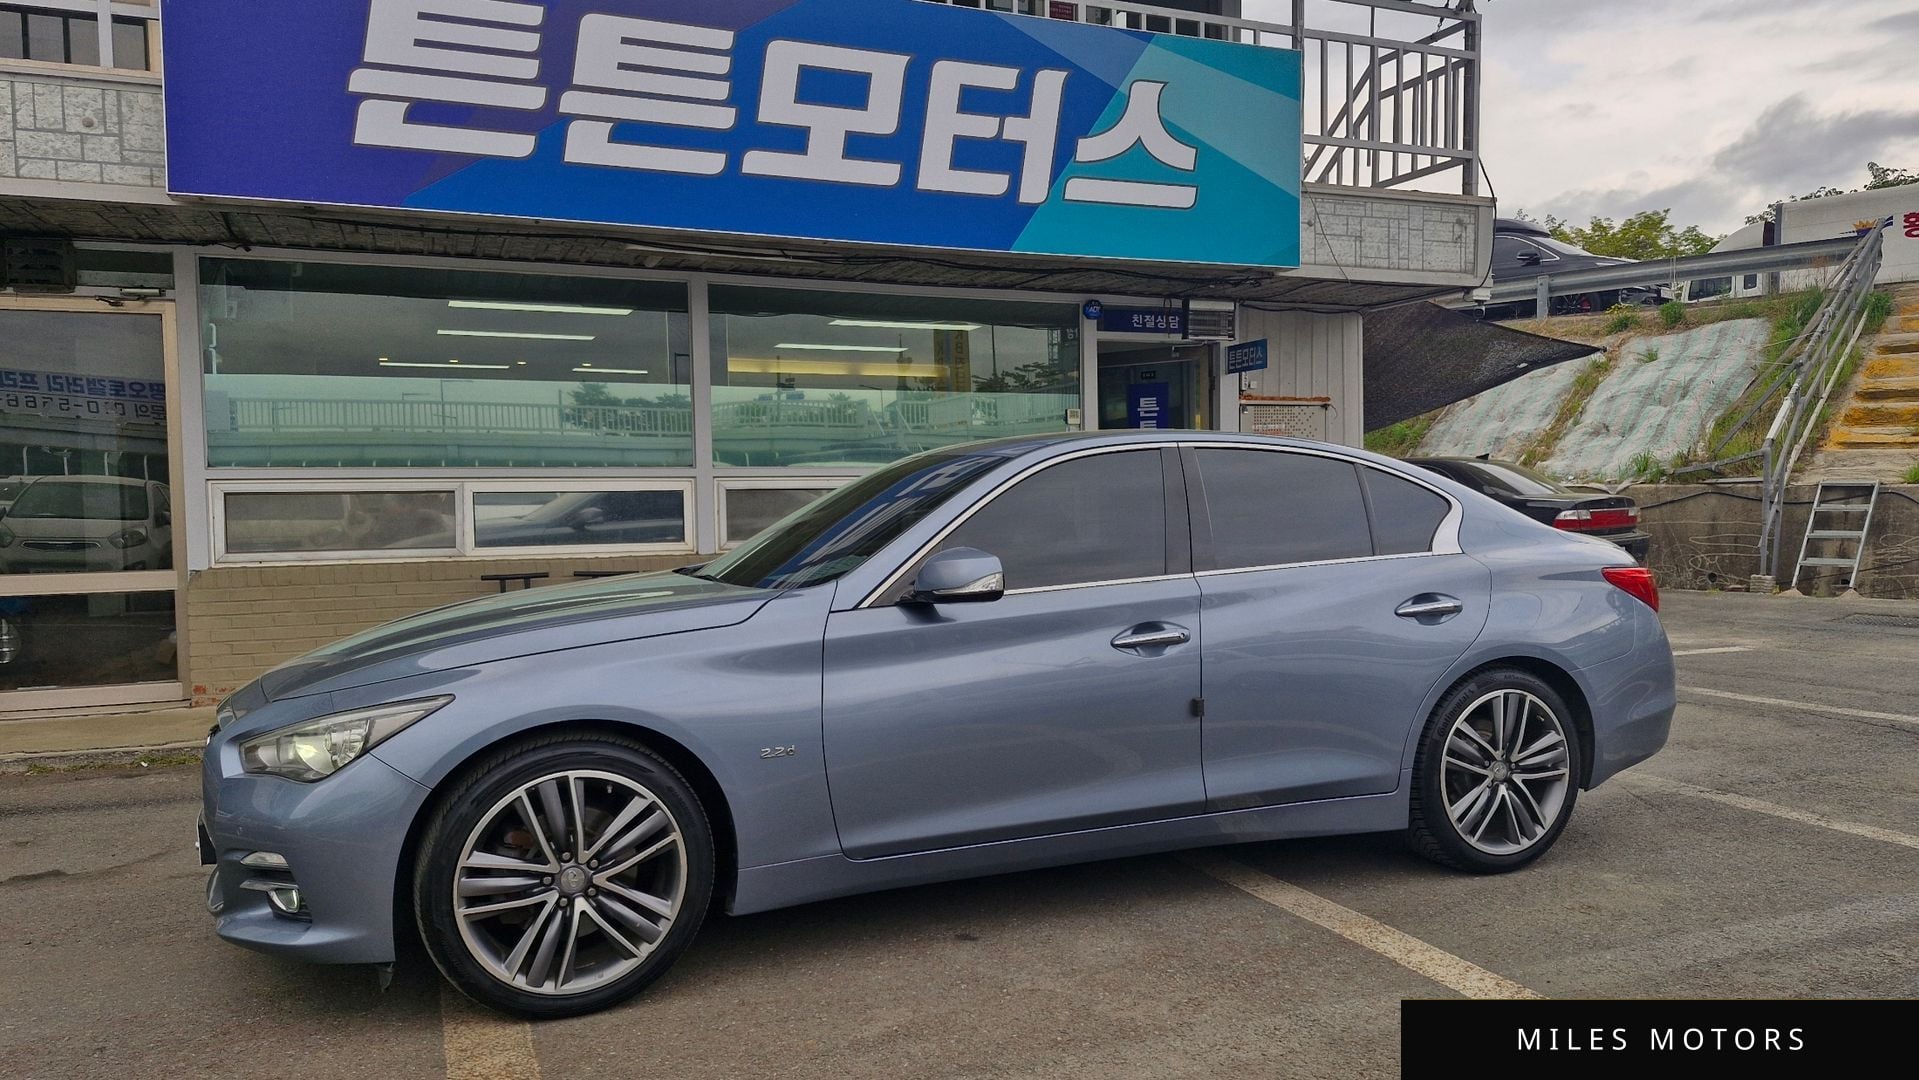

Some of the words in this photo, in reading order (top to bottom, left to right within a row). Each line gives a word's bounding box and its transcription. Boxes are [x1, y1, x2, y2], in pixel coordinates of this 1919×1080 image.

[348, 0, 1198, 209] 튼튼모터스
[1132, 313, 1180, 329] 친절상담
[1229, 346, 1264, 370] 튼튼모터스
